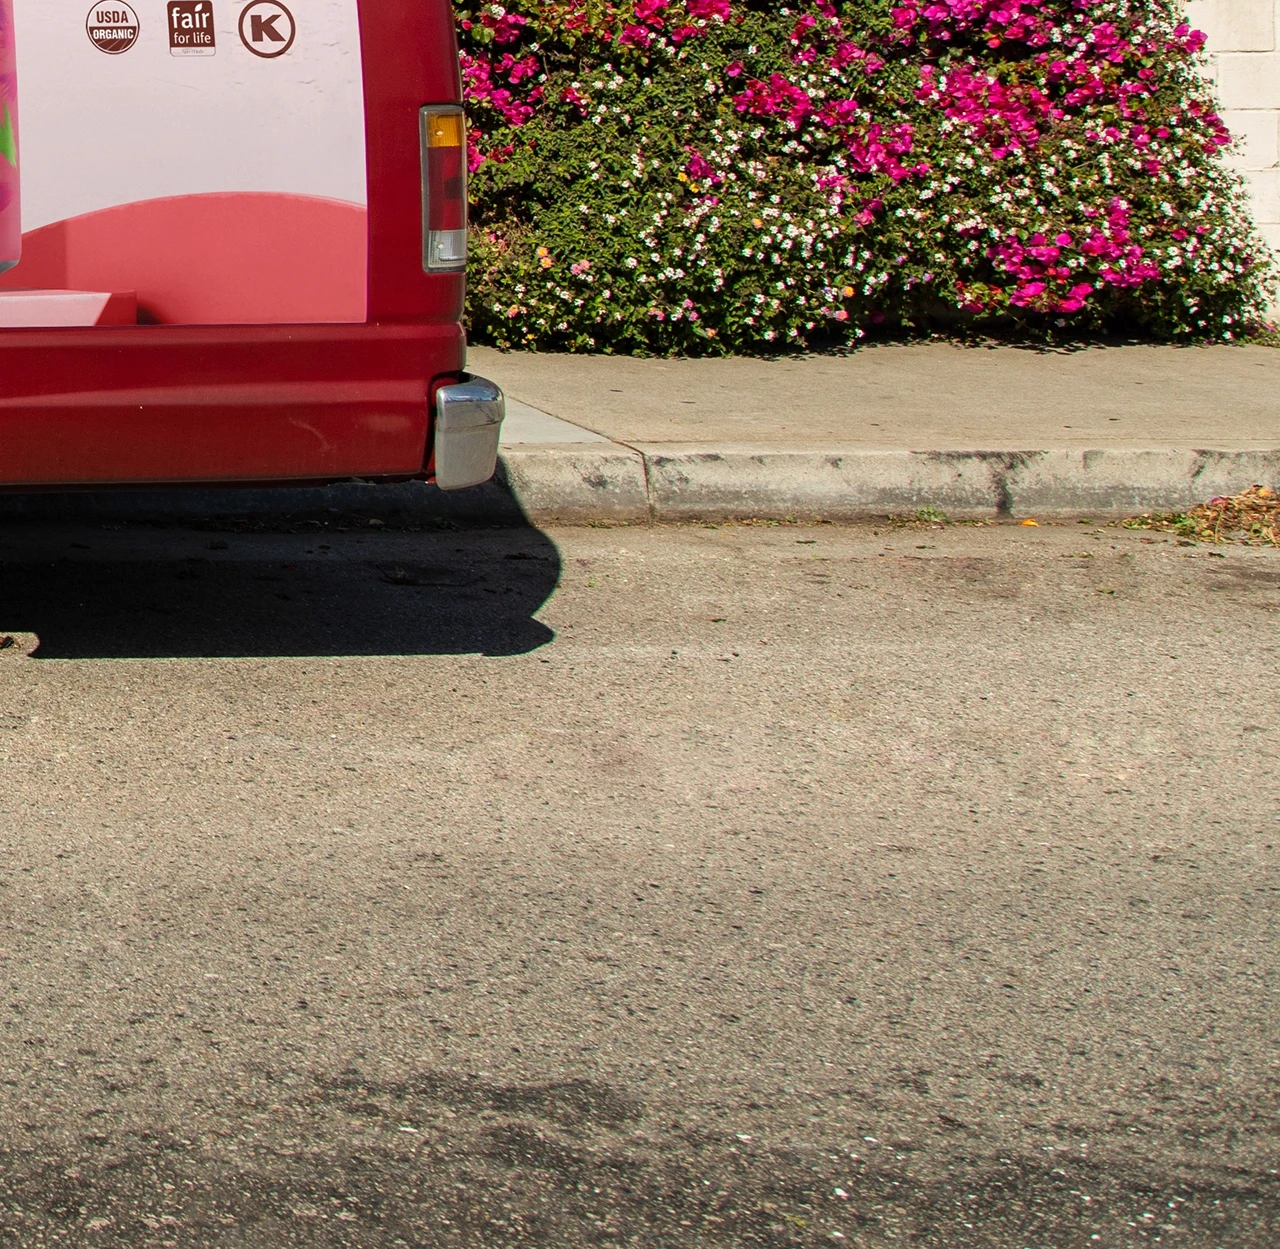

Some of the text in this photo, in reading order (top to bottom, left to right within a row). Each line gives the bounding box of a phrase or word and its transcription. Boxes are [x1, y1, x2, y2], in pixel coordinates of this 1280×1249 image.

[96, 10, 129, 24] USDA
[171, 4, 210, 29] fair
[93, 28, 134, 40] ORGANIC
[250, 14, 286, 42] K
[173, 31, 212, 44] for life
